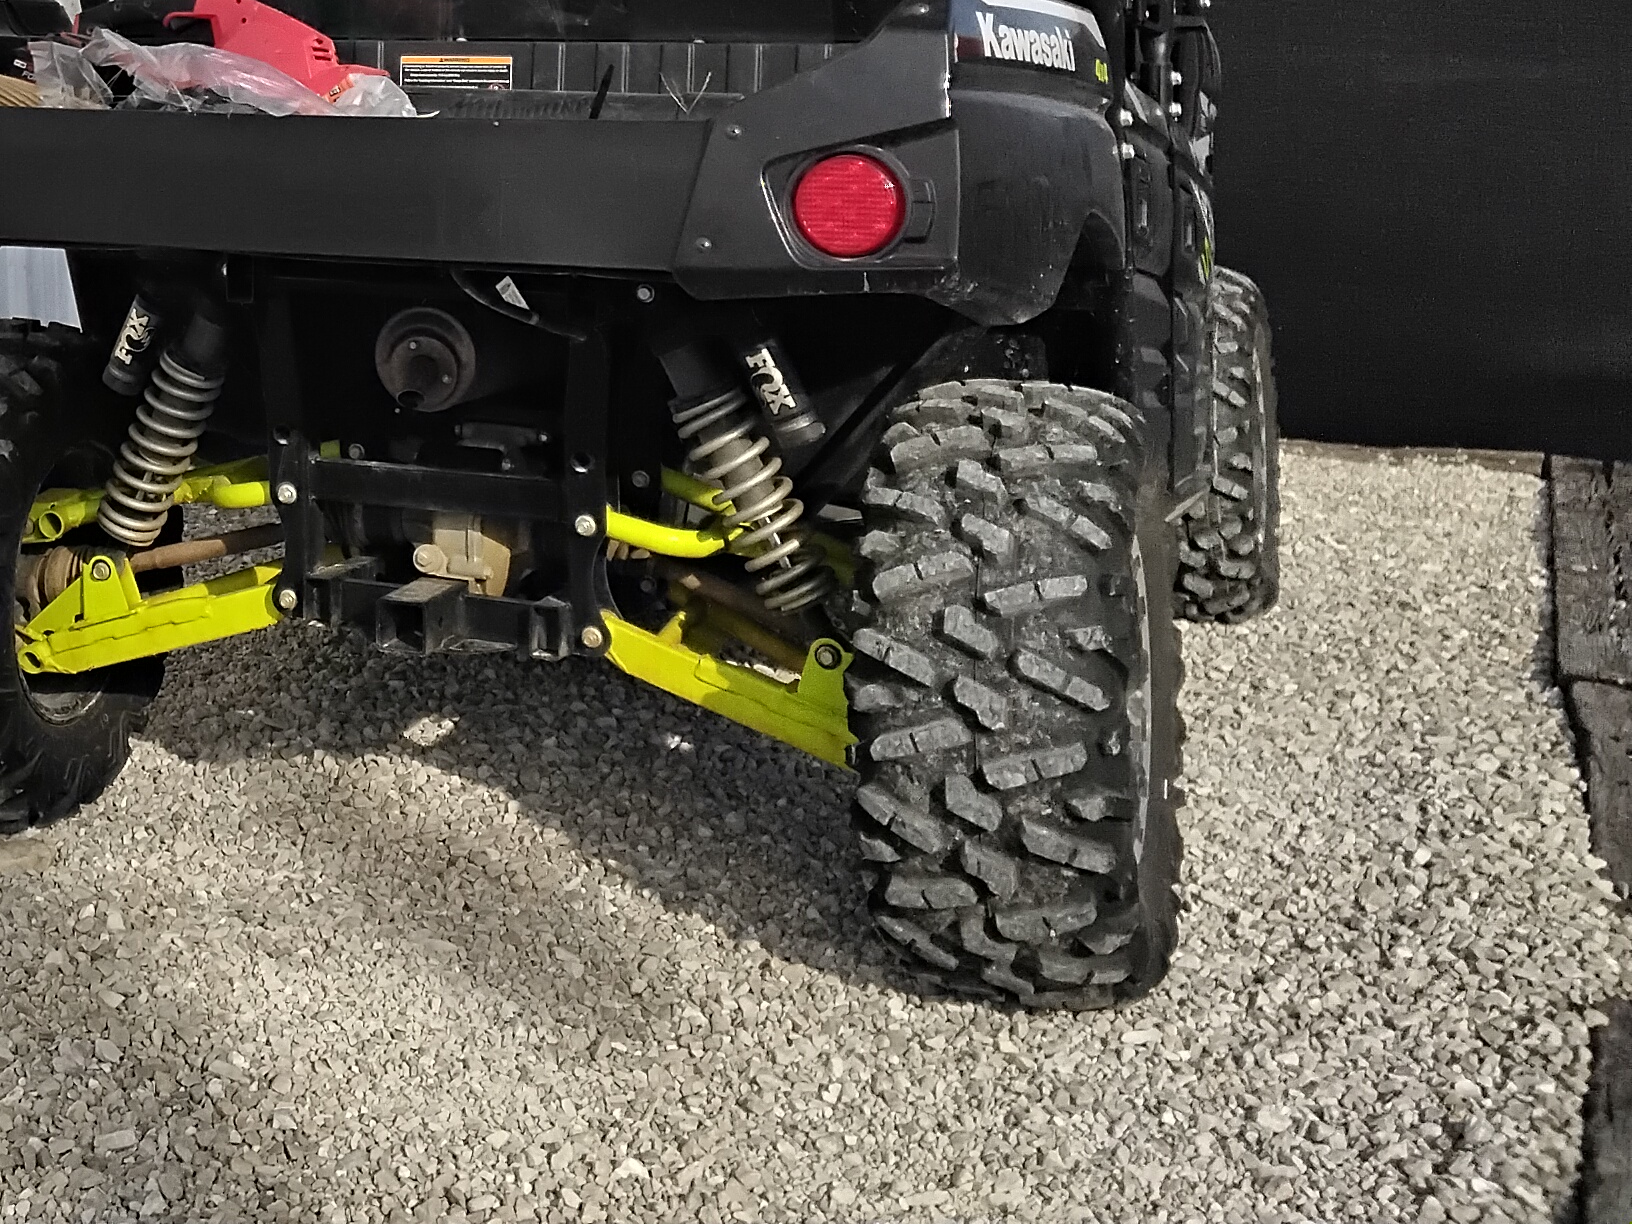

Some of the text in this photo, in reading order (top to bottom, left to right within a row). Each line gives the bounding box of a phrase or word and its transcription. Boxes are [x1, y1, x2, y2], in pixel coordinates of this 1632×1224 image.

[975, 11, 1076, 72] Kawasaki
[114, 308, 151, 365] FOX
[745, 348, 797, 415] FOX
